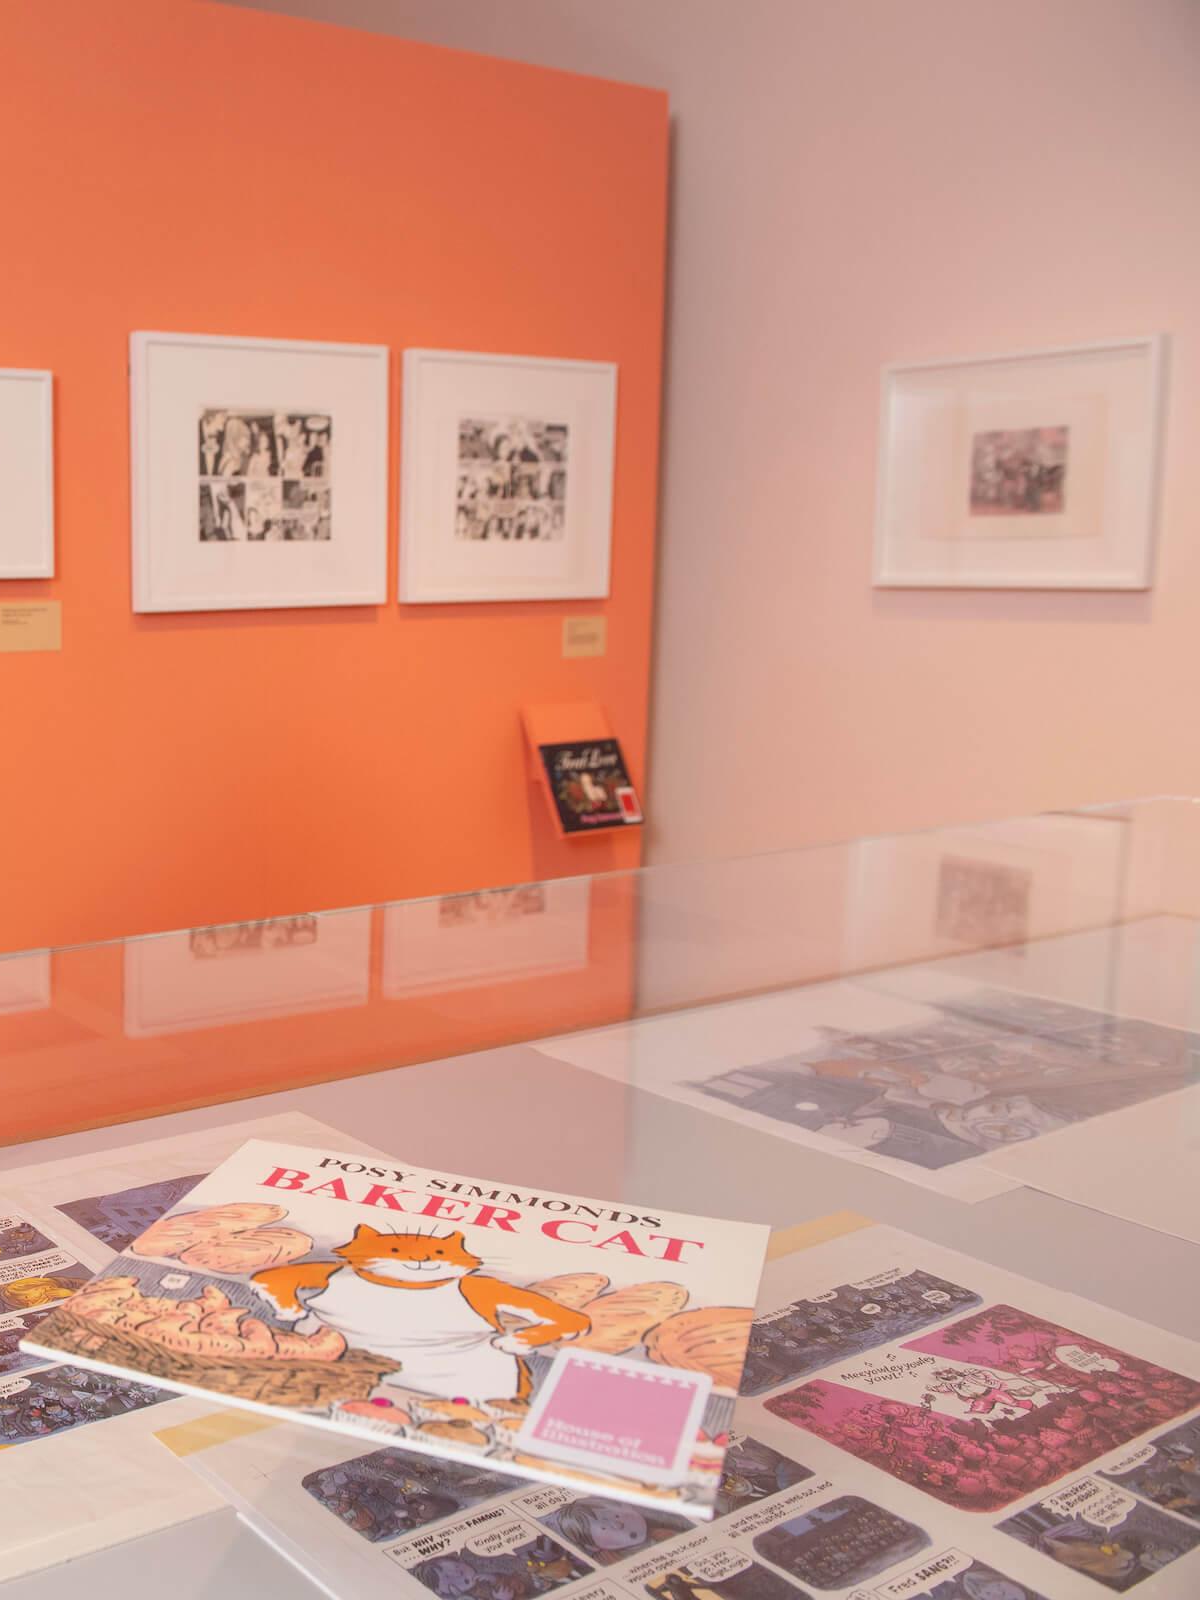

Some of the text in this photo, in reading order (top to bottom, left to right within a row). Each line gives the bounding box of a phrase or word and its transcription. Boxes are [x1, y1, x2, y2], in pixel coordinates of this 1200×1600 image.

[256, 1166, 704, 1264] BAKER CAT
[319, 1158, 663, 1229] POSY SIMMONDS
[546, 1418, 642, 1450] House of
[411, 1536, 434, 1548] WHY
[465, 1508, 505, 1528] FAMOUS?
